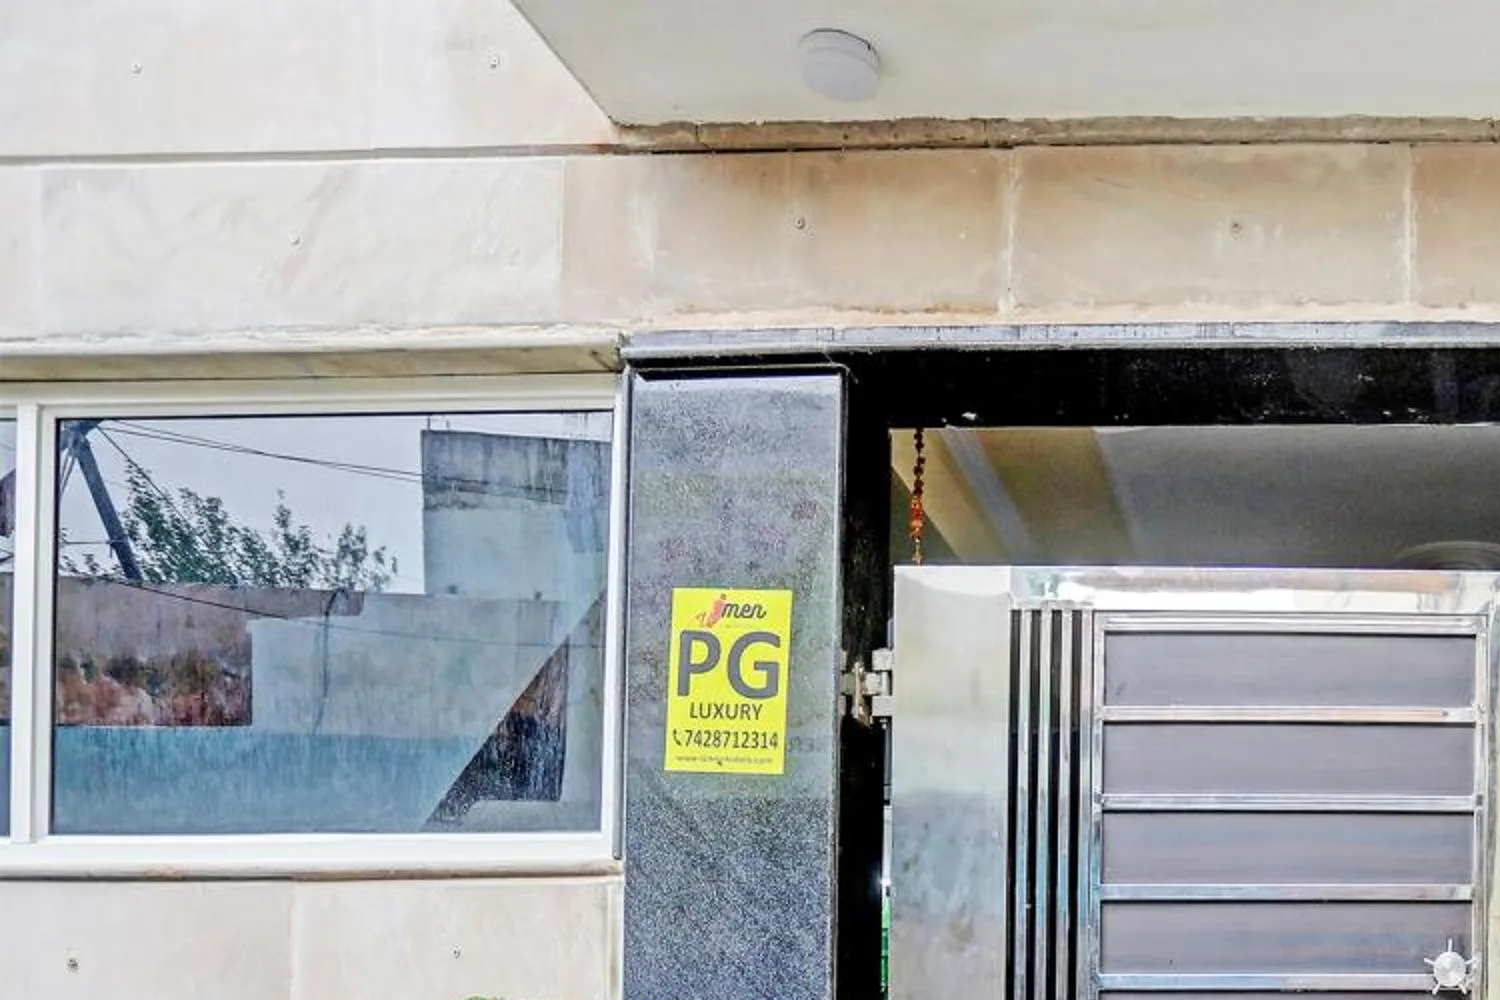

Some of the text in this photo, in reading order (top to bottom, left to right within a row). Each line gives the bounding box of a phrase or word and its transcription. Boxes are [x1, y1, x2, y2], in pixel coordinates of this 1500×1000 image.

[677, 630, 781, 699] PG
[690, 702, 763, 720] LUXURY
[684, 730, 778, 748] 7428712314
